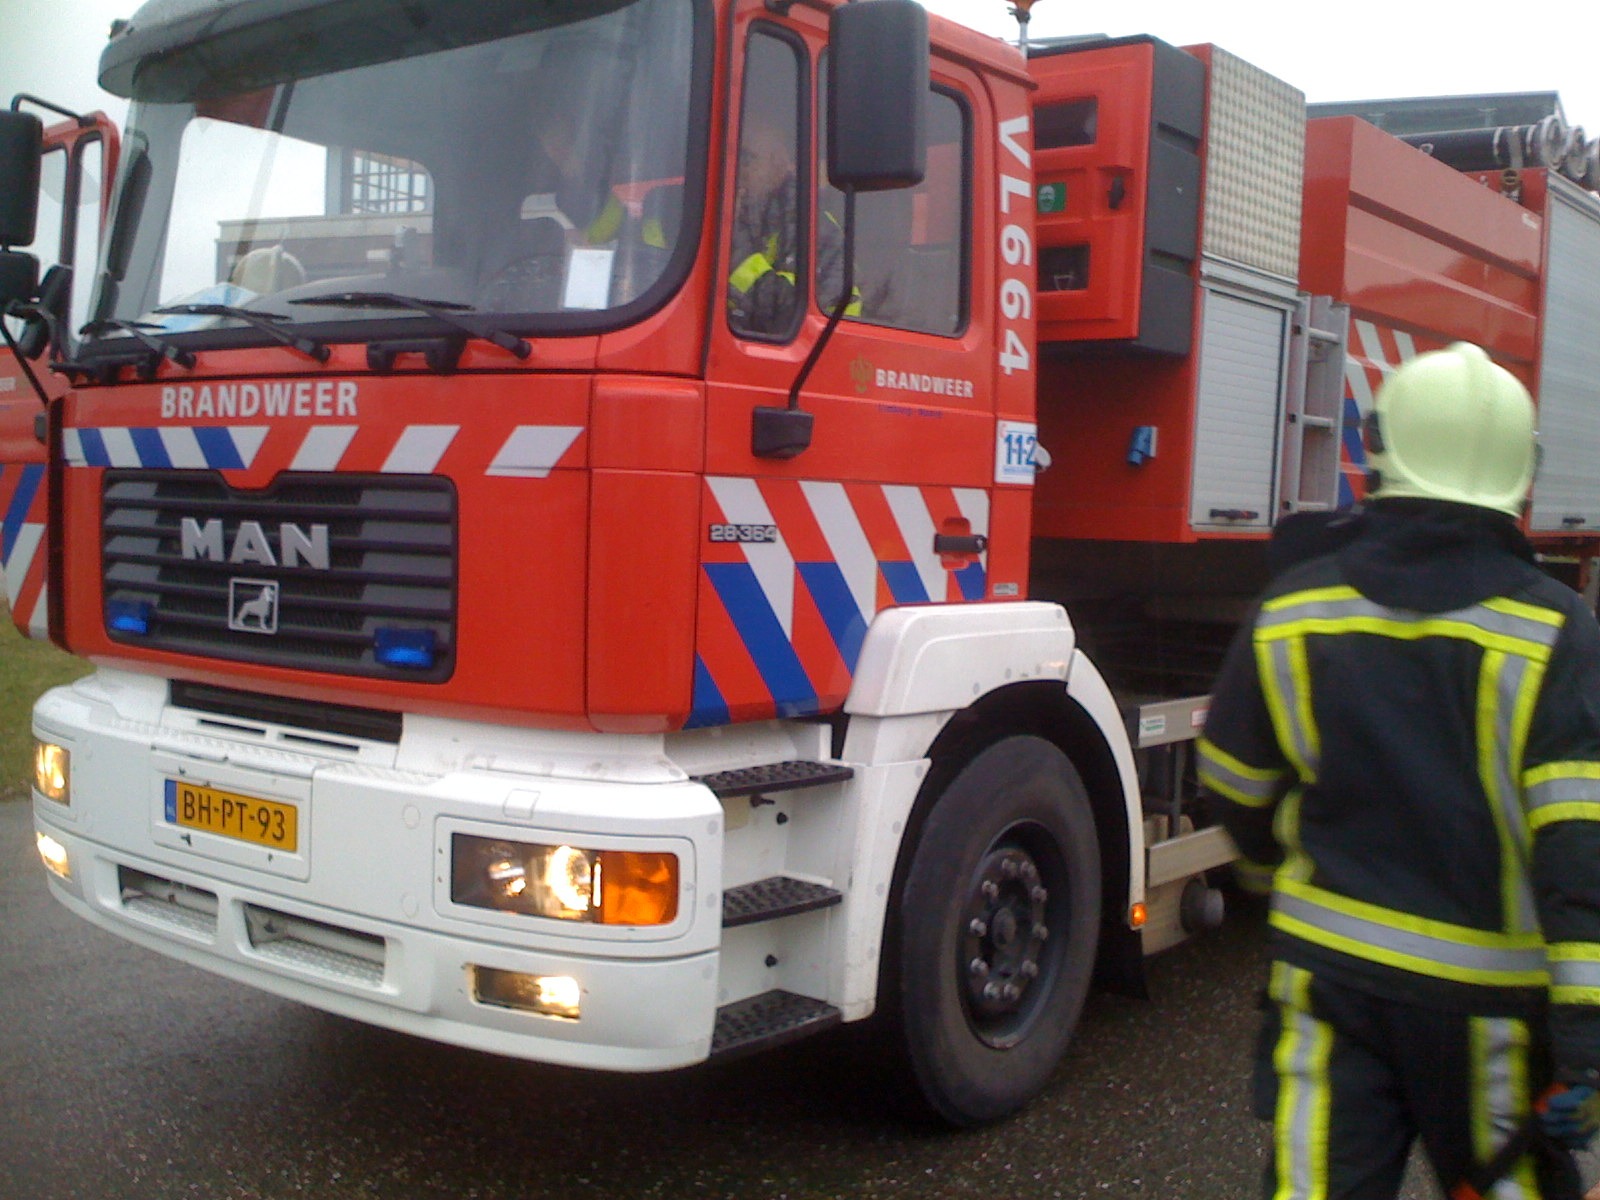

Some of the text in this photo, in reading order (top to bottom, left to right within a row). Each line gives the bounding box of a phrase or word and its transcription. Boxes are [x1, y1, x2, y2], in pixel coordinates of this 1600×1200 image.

[998, 115, 1031, 375] VL664
[161, 381, 358, 418] BRANDWEER
[875, 368, 974, 398] BRANDWEER
[181, 517, 329, 570] MAN
[183, 790, 285, 841] BH-PT-93
